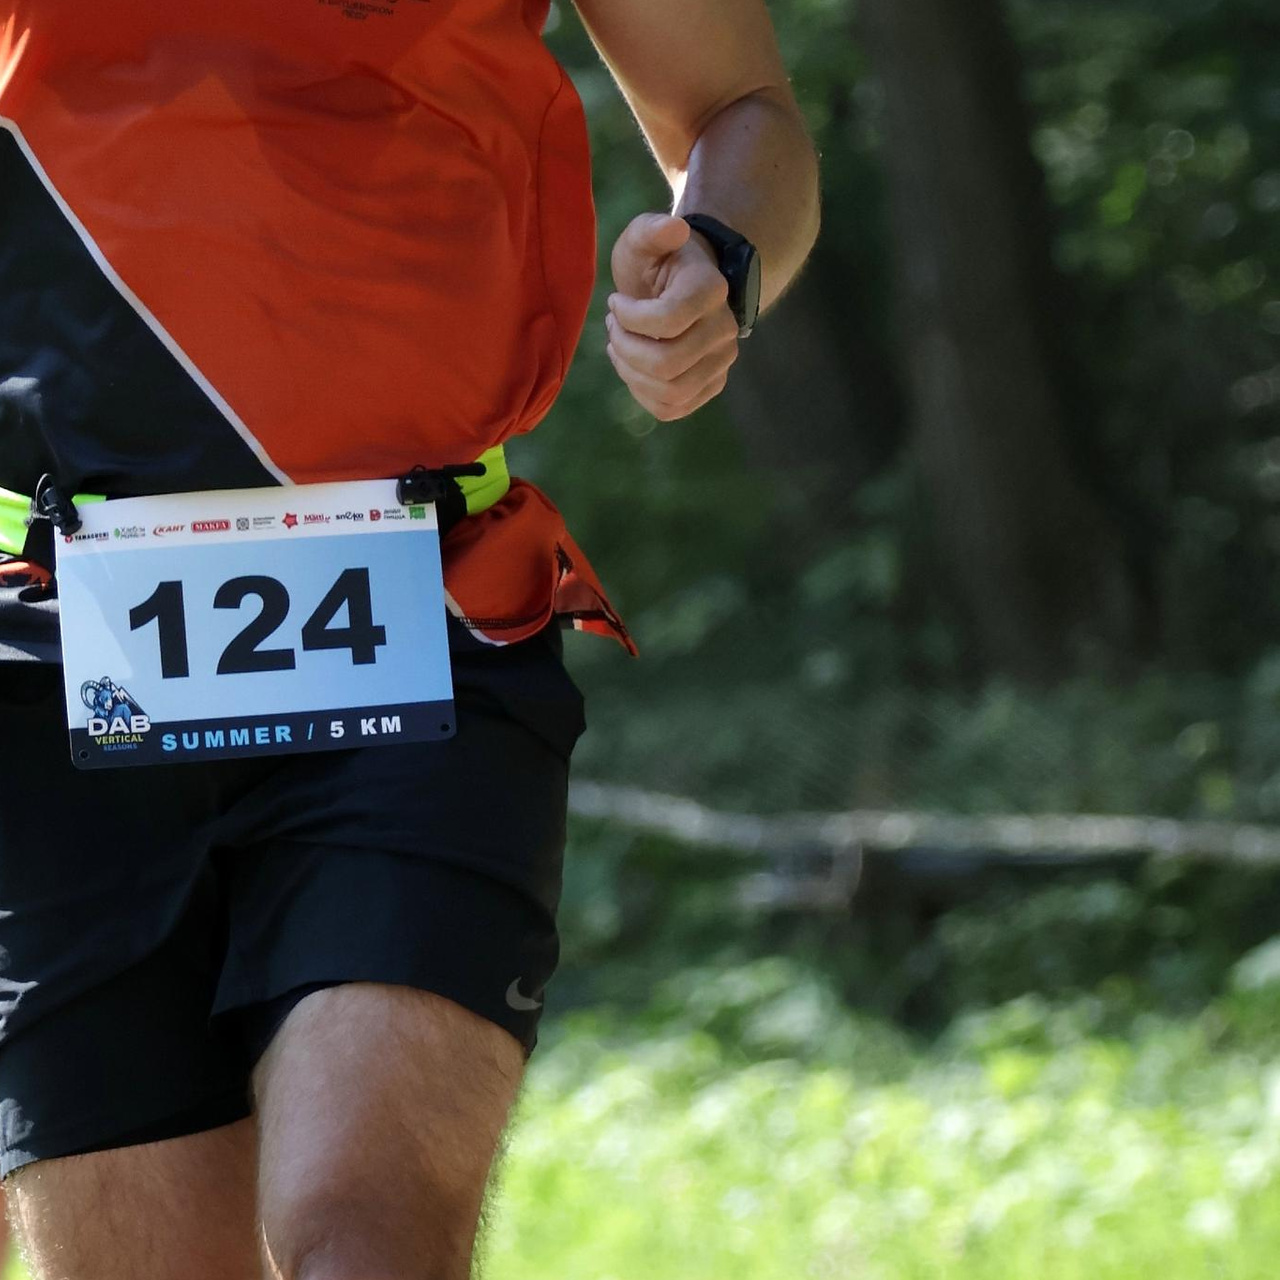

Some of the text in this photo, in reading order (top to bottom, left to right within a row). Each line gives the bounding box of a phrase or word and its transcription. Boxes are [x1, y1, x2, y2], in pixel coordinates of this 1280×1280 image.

[129, 567, 386, 680] 124
[88, 714, 151, 737] DAB
[95, 733, 144, 746] VERTICAL
[162, 715, 402, 752] SUMMER / 5 KM
